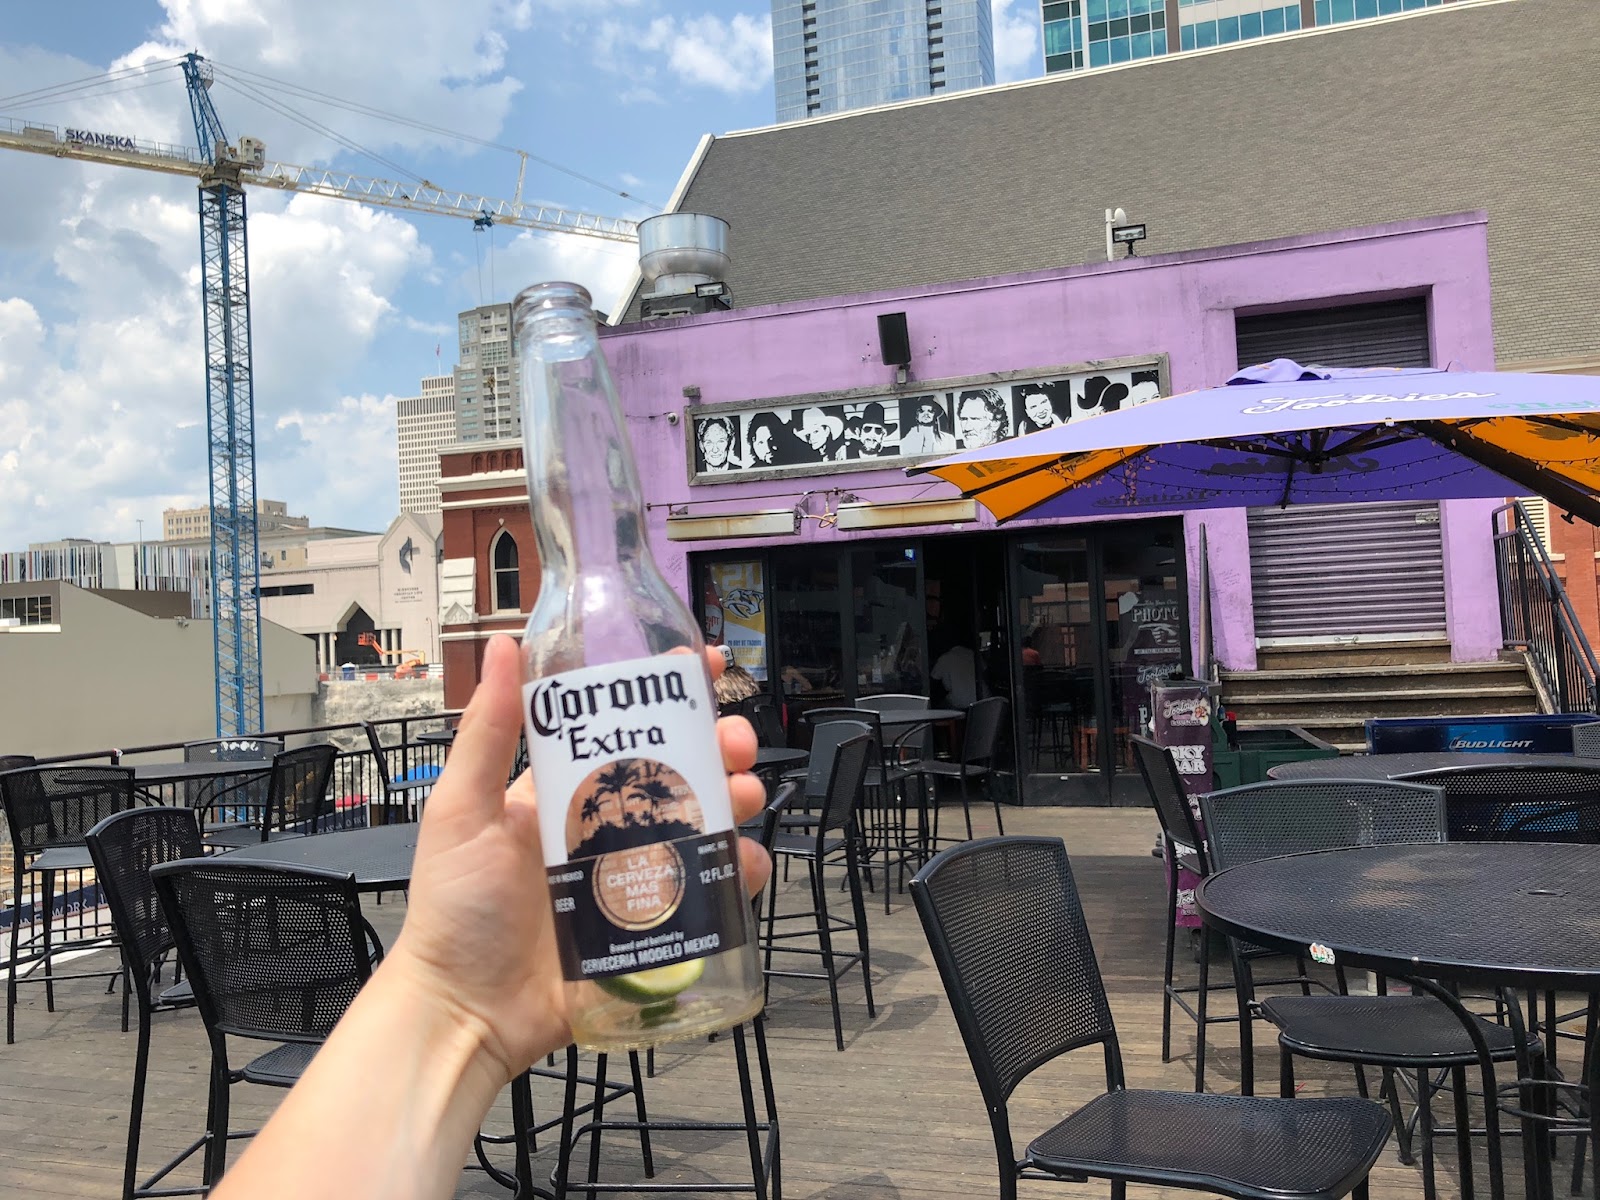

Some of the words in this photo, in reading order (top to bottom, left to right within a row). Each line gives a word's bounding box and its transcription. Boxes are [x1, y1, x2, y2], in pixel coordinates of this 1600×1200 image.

[66, 129, 135, 148] SKANSKA
[1242, 392, 1498, 415] Tootsies
[531, 670, 688, 740] Corona
[568, 725, 666, 761] Extra
[1455, 740, 1488, 749] BUD
[1489, 740, 1533, 749] LIGHT
[1174, 760, 1207, 774] AR
[627, 855, 649, 869] LA
[606, 864, 675, 888] CERVEZA
[699, 869, 711, 884] 12
[625, 881, 660, 898] MAS
[555, 897, 576, 913] BEER
[626, 897, 662, 912] FINA
[636, 936, 649, 949] and
[675, 930, 684, 941] by
[581, 953, 637, 974] CERVECERIA
[638, 943, 682, 965] MODELO
[684, 933, 720, 955] MEXICO
